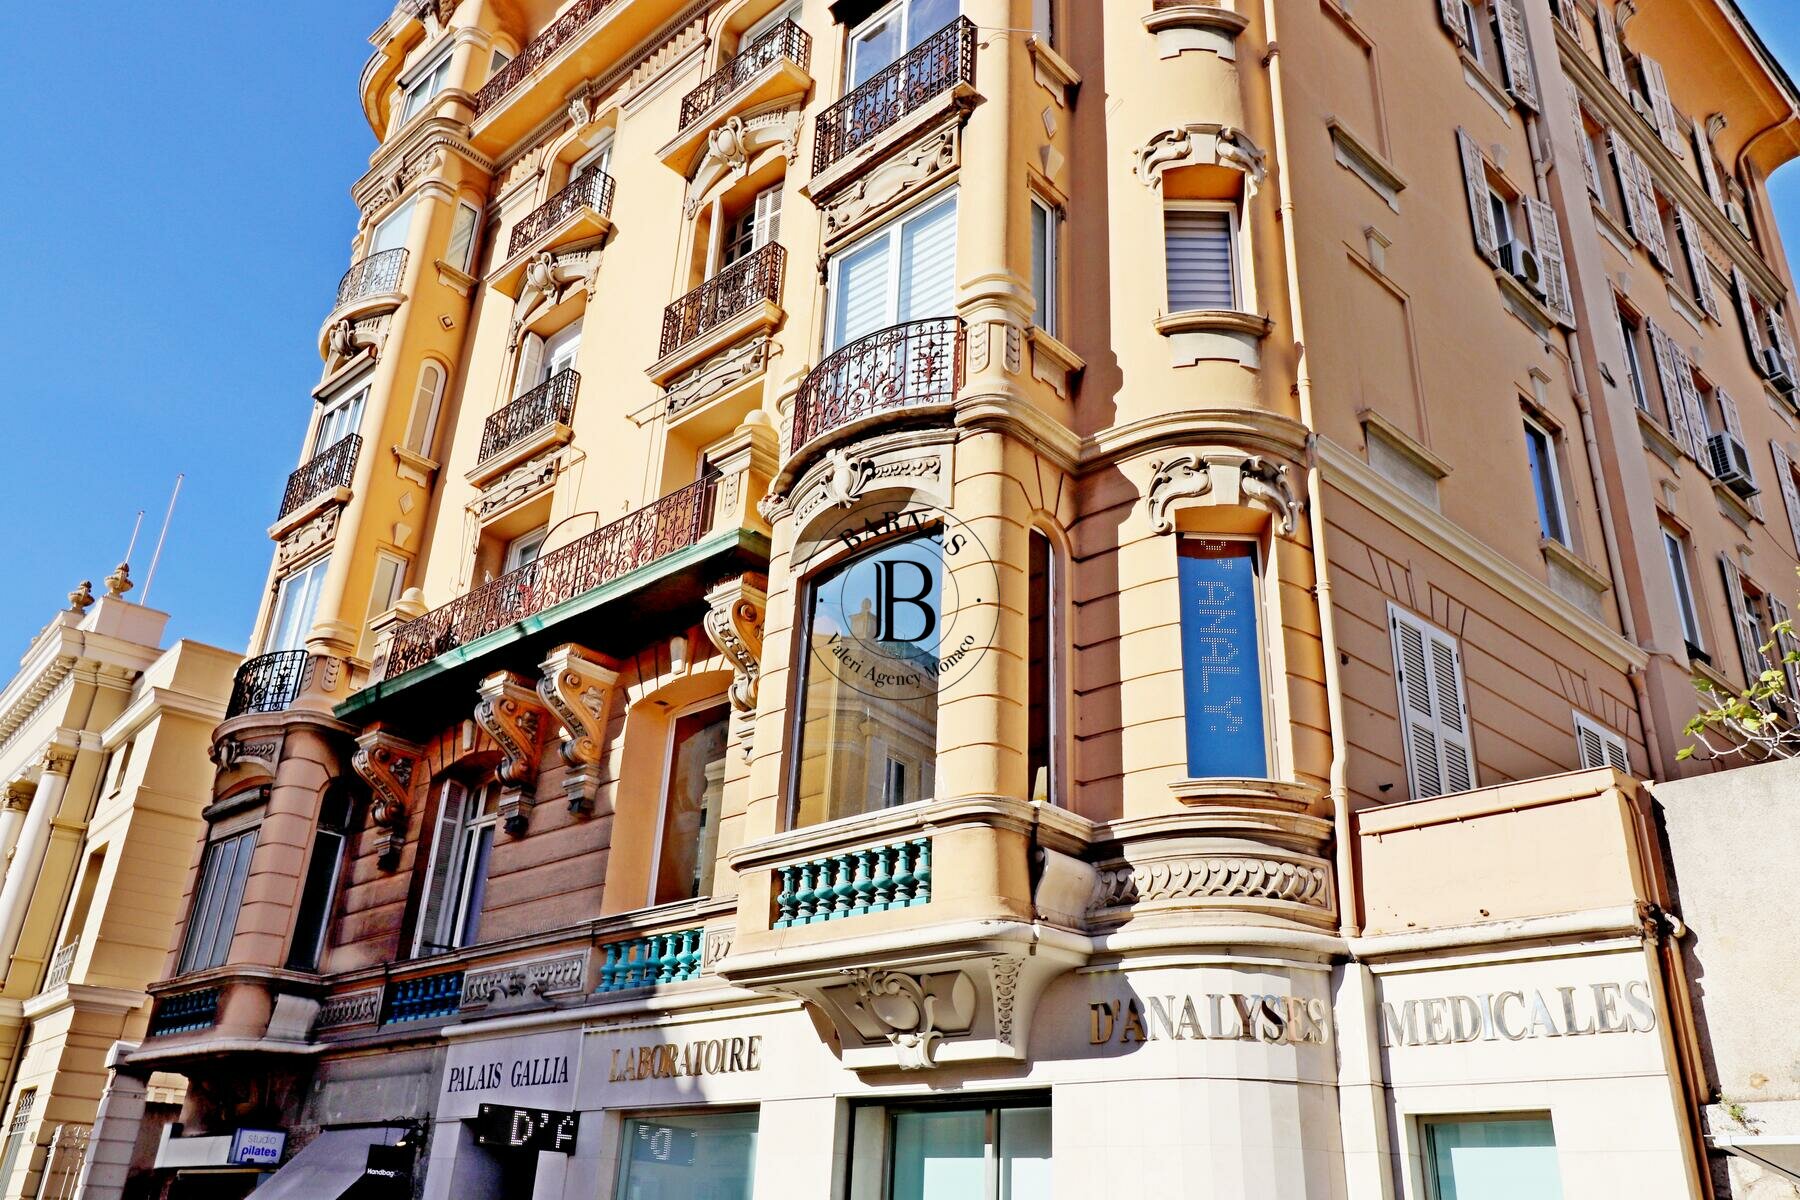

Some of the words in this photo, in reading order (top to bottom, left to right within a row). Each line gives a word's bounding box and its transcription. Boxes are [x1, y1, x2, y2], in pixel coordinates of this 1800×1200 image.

[608, 1035, 763, 1083] LABORATOIRE
[1089, 993, 1328, 1046] D'ANALYSES
[1379, 980, 1656, 1048] MEDICALES
[447, 1062, 503, 1093] PALAIS
[511, 1056, 569, 1088] GALLIA
[240, 1145, 277, 1161] pilates
